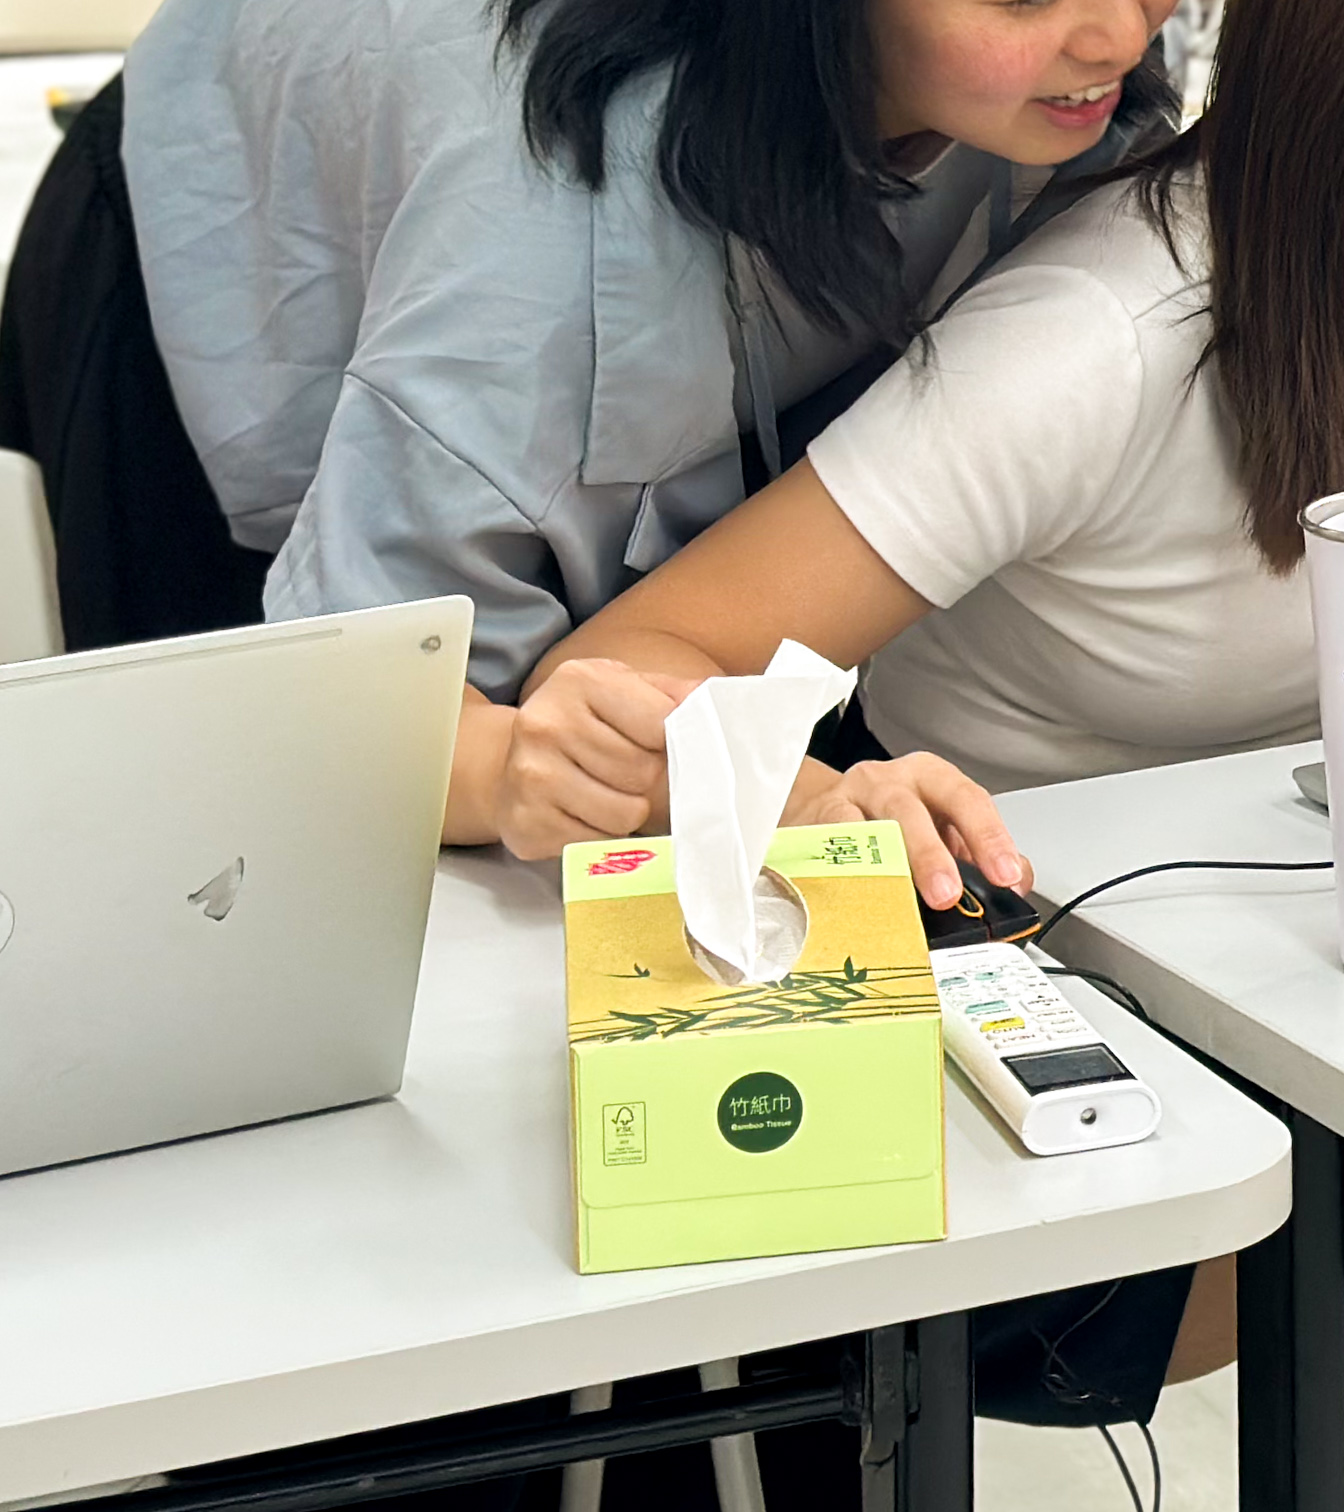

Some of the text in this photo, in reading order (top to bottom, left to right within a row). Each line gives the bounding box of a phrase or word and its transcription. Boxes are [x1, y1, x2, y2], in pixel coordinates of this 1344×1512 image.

[729, 1094, 792, 1117] 竹紙巾
[731, 1120, 765, 1131] Bamboo
